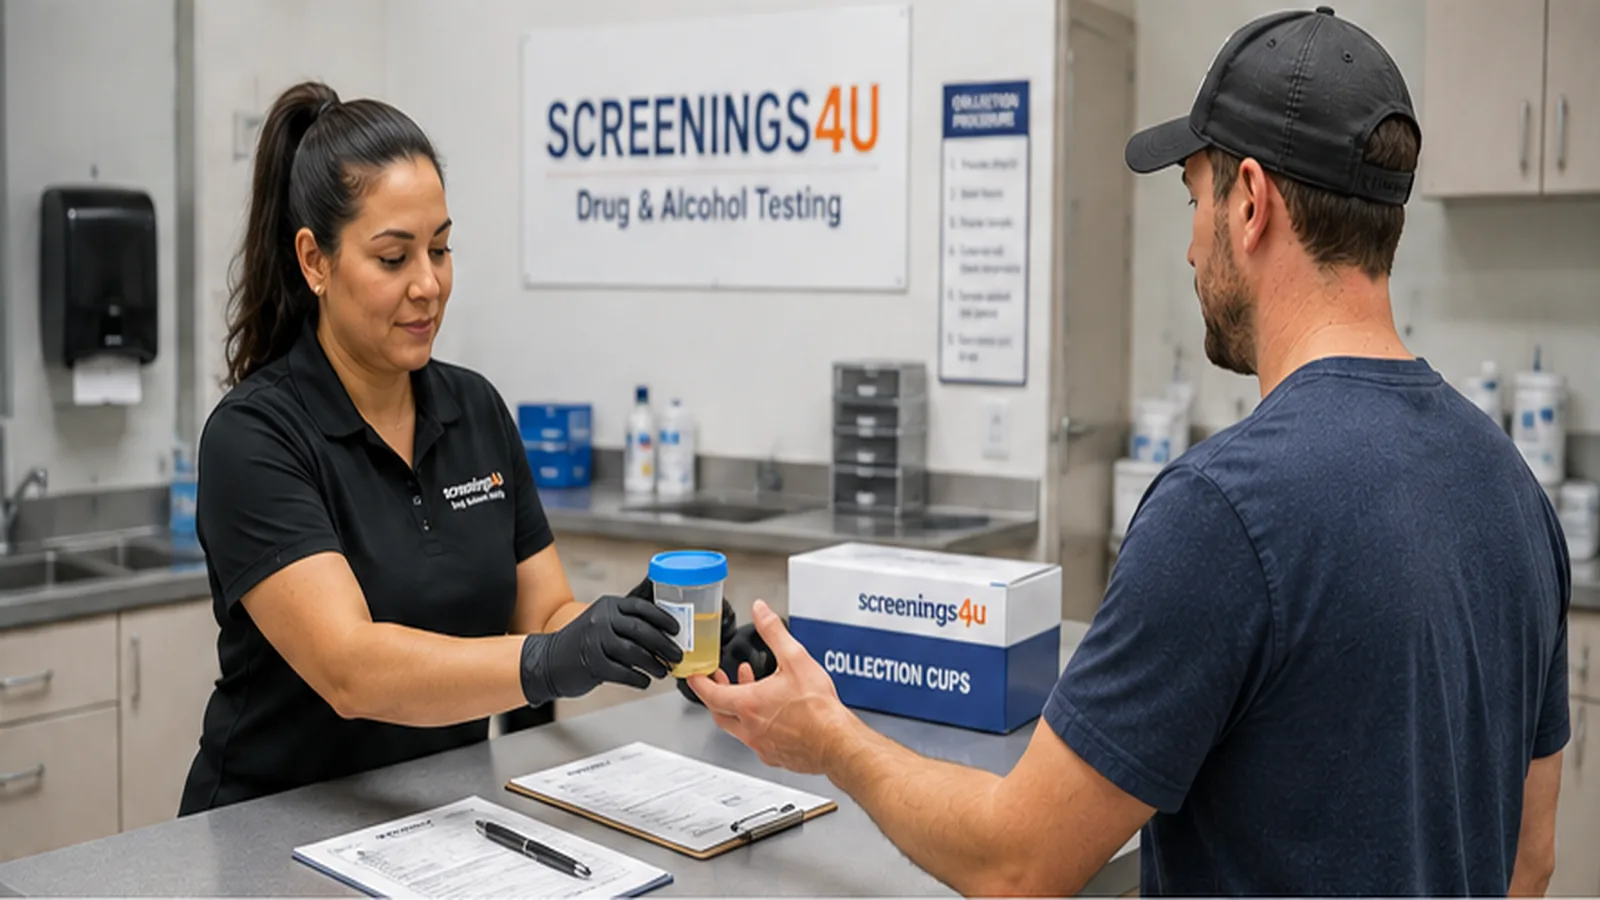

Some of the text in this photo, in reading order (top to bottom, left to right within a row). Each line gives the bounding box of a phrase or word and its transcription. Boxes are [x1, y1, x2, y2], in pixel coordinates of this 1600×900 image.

[547, 83, 879, 158] SCREENINGS4U
[577, 185, 842, 230] Drug & Alcohol Testing
[858, 594, 986, 628] screenings4u
[825, 650, 971, 694] COLLECTION CUPS
